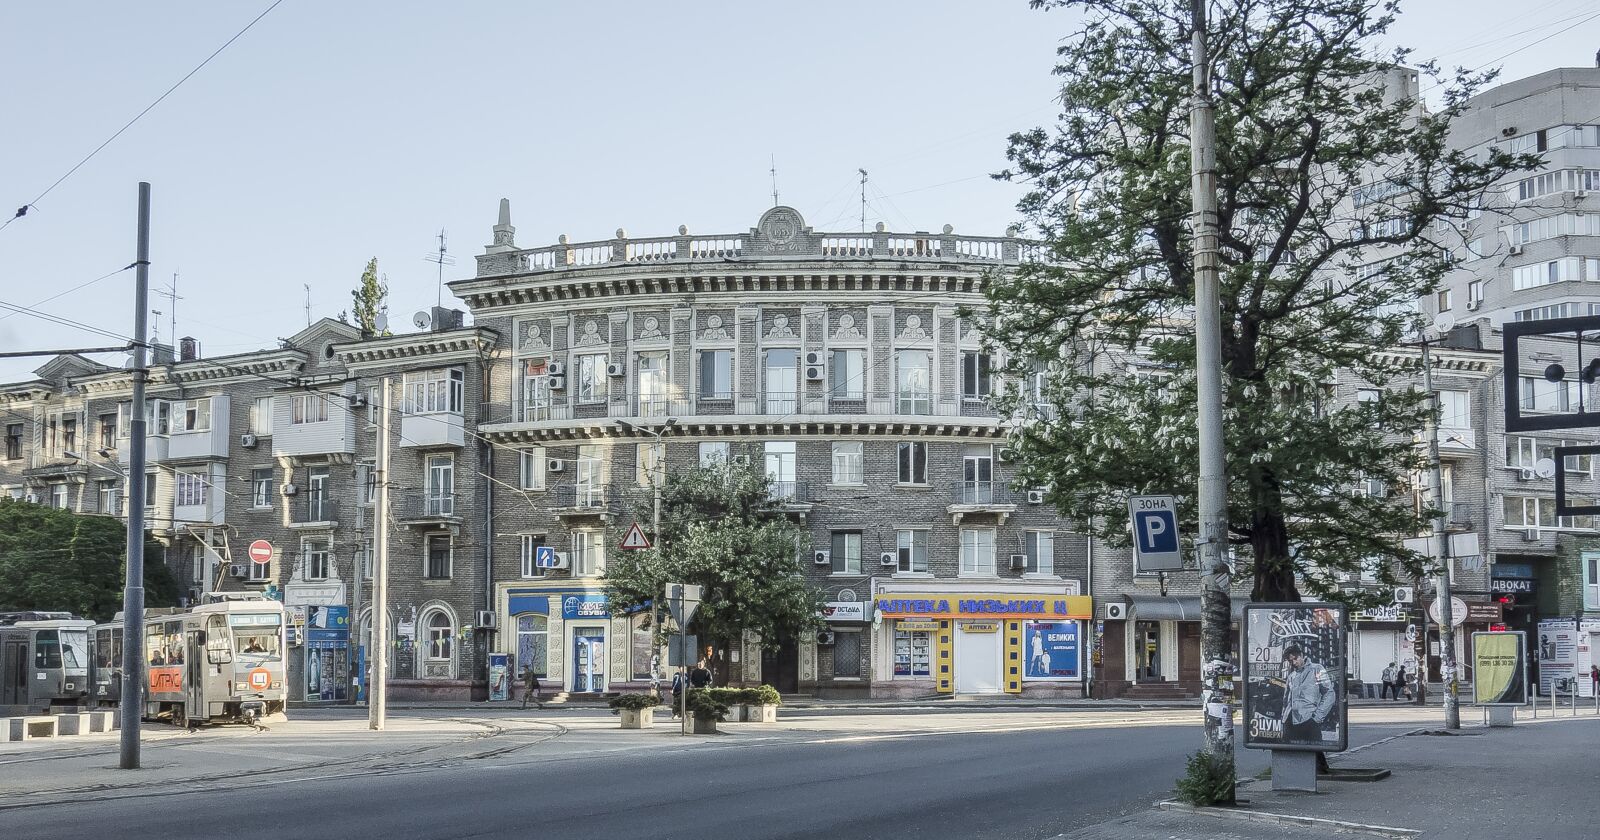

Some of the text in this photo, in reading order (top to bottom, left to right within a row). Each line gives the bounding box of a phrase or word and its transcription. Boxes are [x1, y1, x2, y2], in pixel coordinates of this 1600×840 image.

[1140, 500, 1167, 509] ЗОНА
[1145, 515, 1166, 548] P
[578, 602, 605, 610] МИР
[879, 599, 950, 613] АПТЕКА
[958, 599, 1046, 614] НИЗЬКИХ
[1047, 633, 1075, 642] ВЕЛИКИХ
[1259, 719, 1281, 732] ЦУМ
